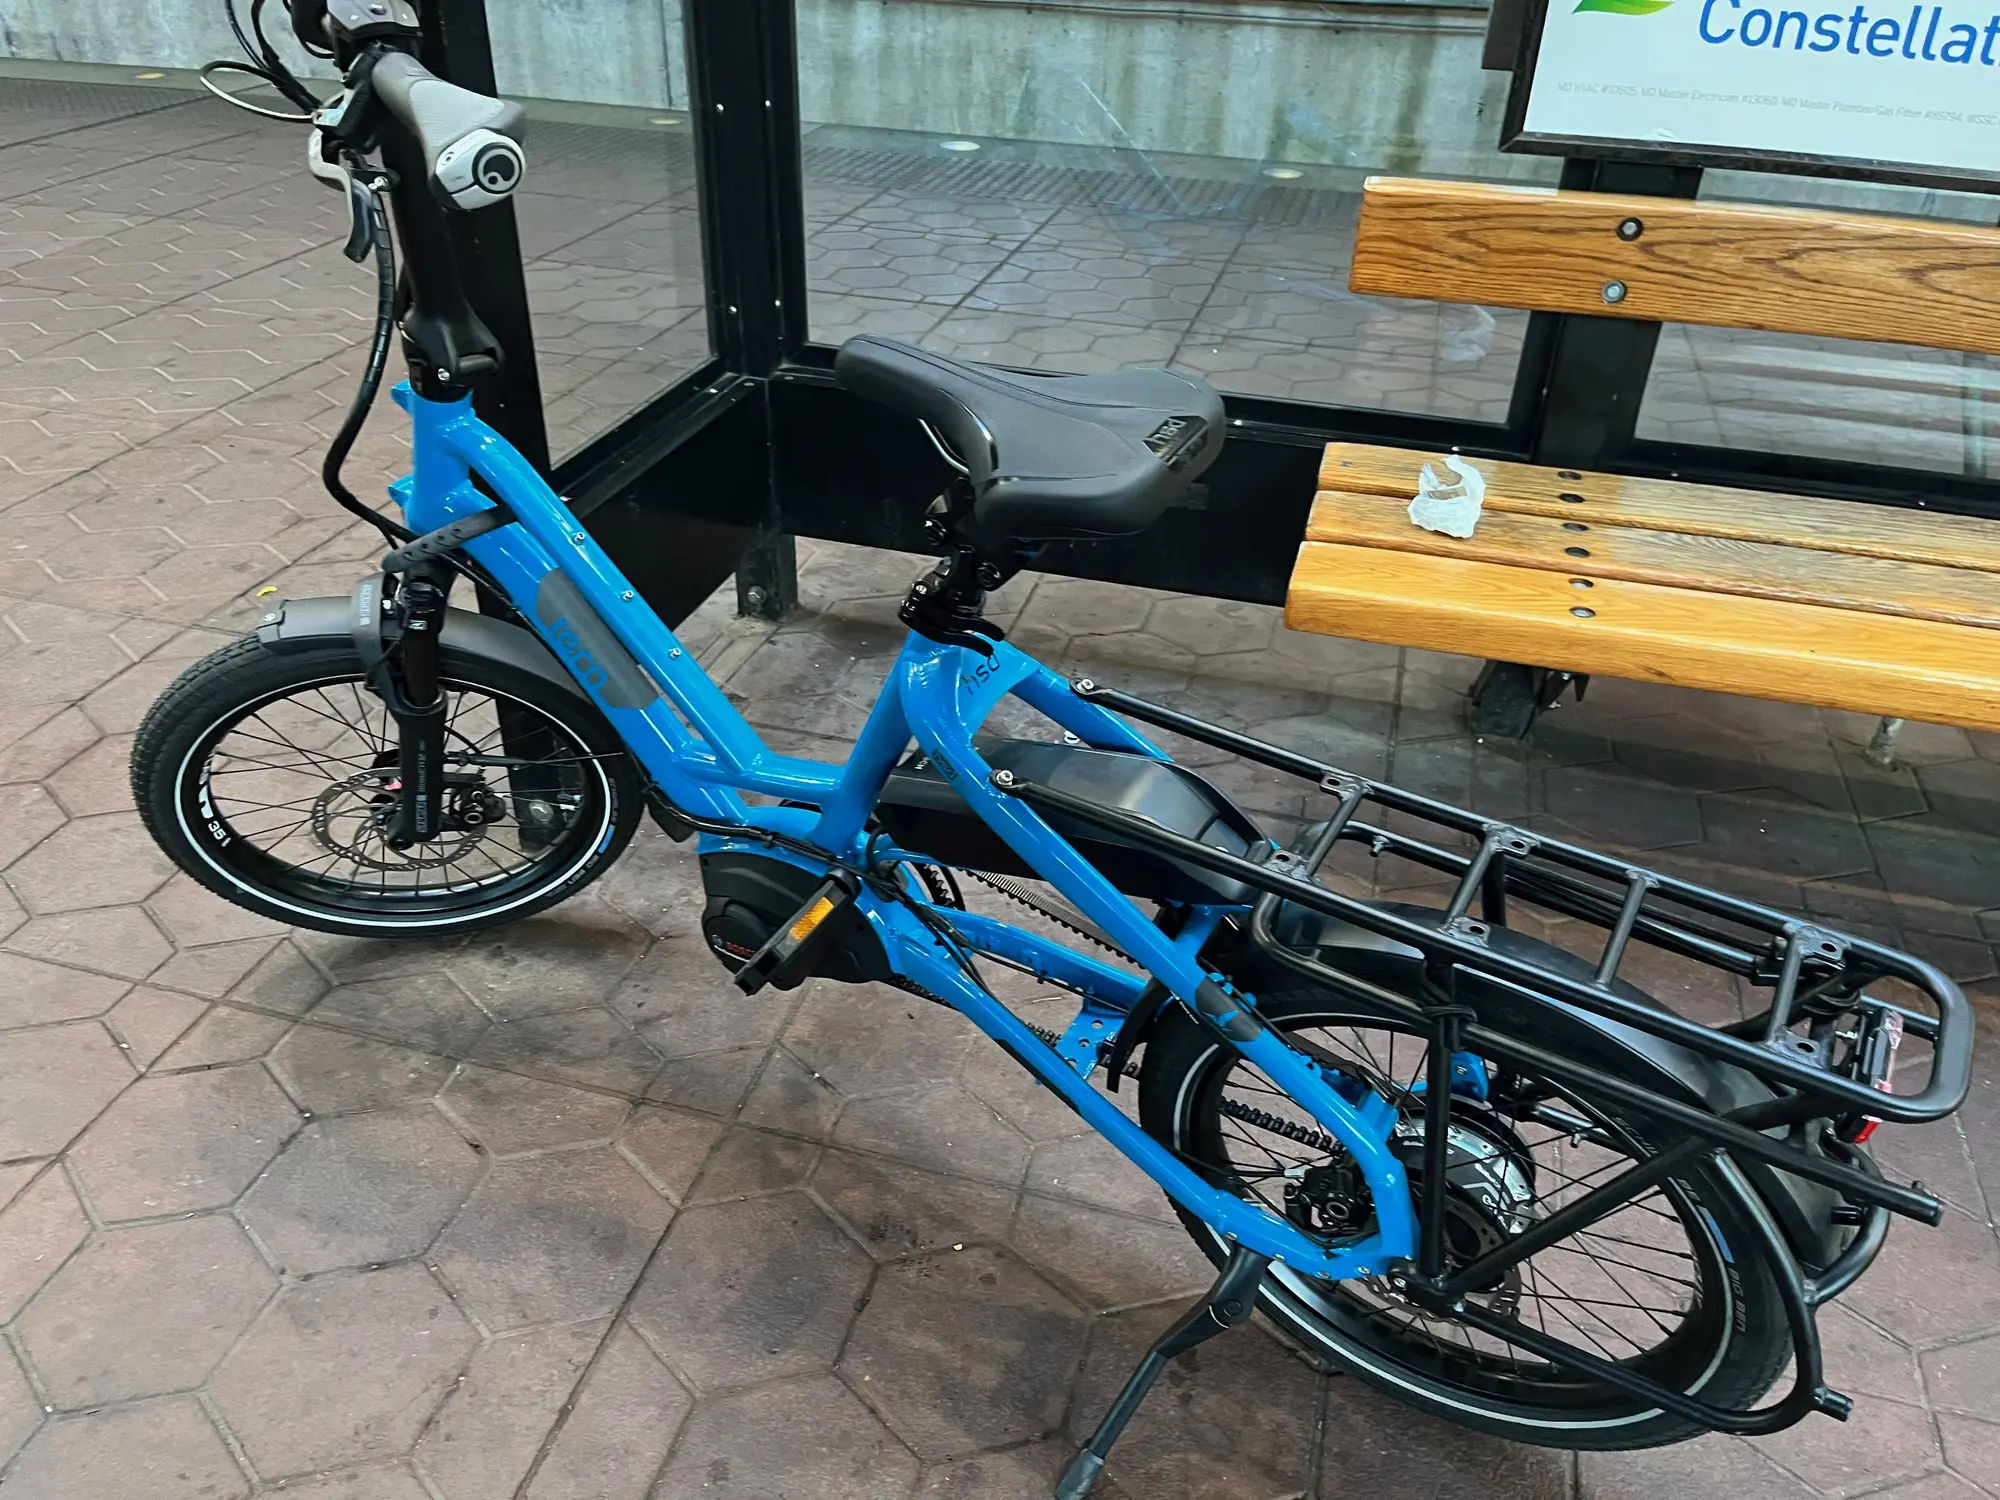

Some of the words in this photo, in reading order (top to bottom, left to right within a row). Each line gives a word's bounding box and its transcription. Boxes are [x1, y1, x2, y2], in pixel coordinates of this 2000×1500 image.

[1574, 83, 1600, 94] HVAC
[1658, 88, 1690, 100] Master
[1799, 98, 1831, 110] Master
[550, 616, 609, 692] tern
